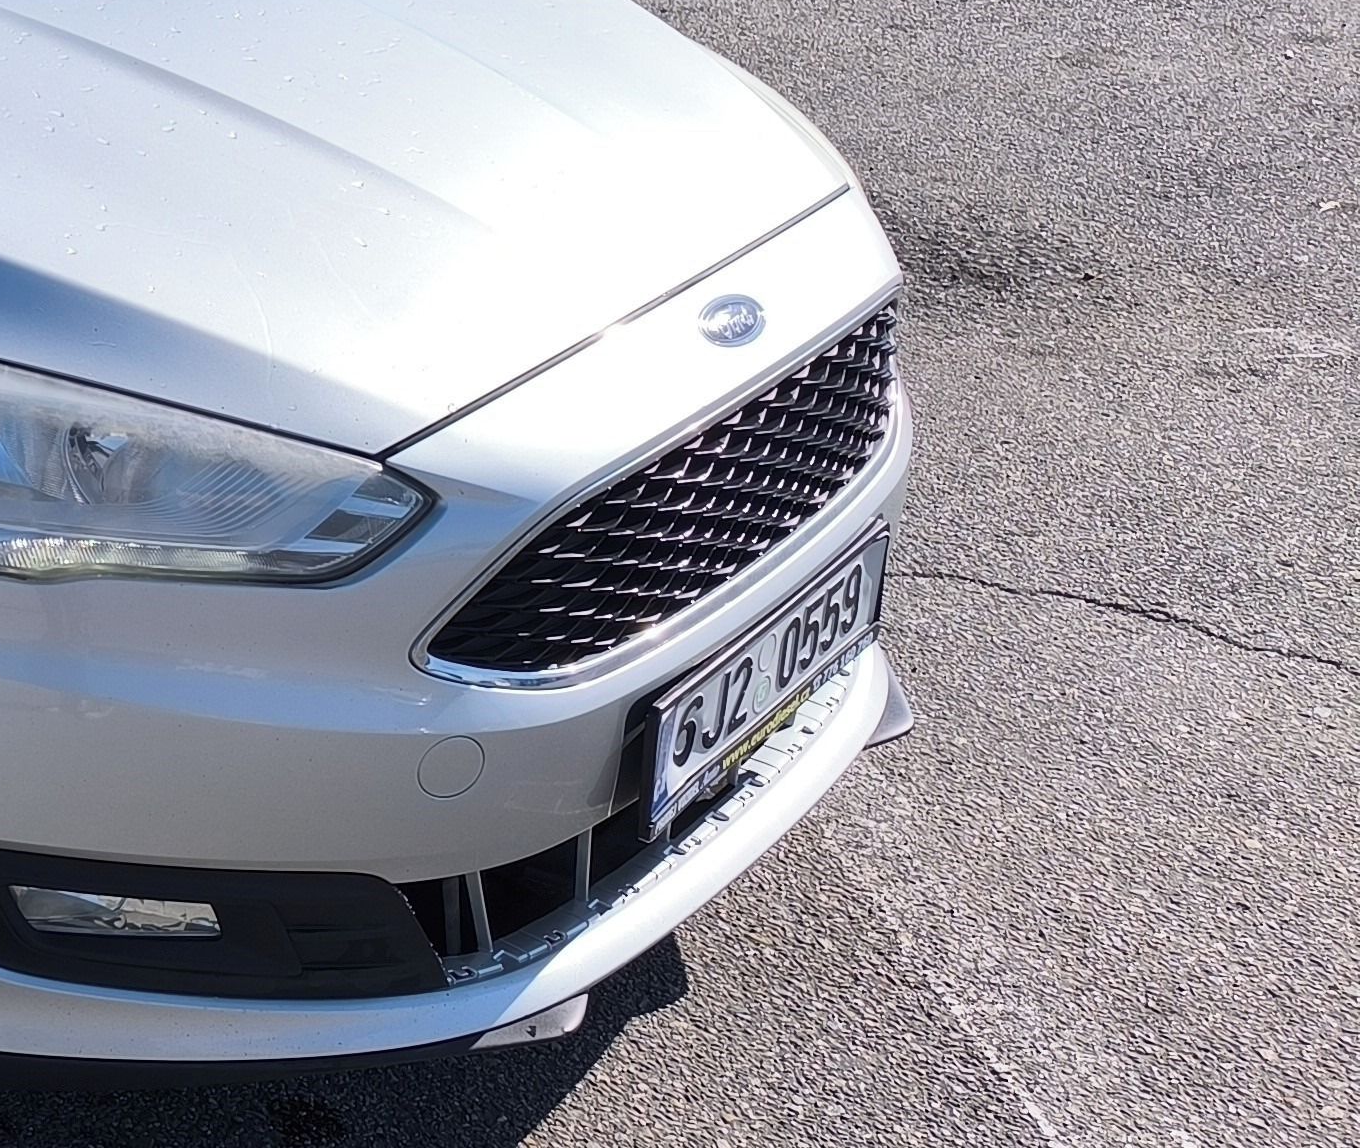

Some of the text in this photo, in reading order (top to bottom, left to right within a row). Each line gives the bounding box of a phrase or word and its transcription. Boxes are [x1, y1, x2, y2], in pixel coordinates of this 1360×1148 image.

[672, 563, 863, 767] 6J2 0559
[722, 688, 811, 770] www.eurodiesel.cz
